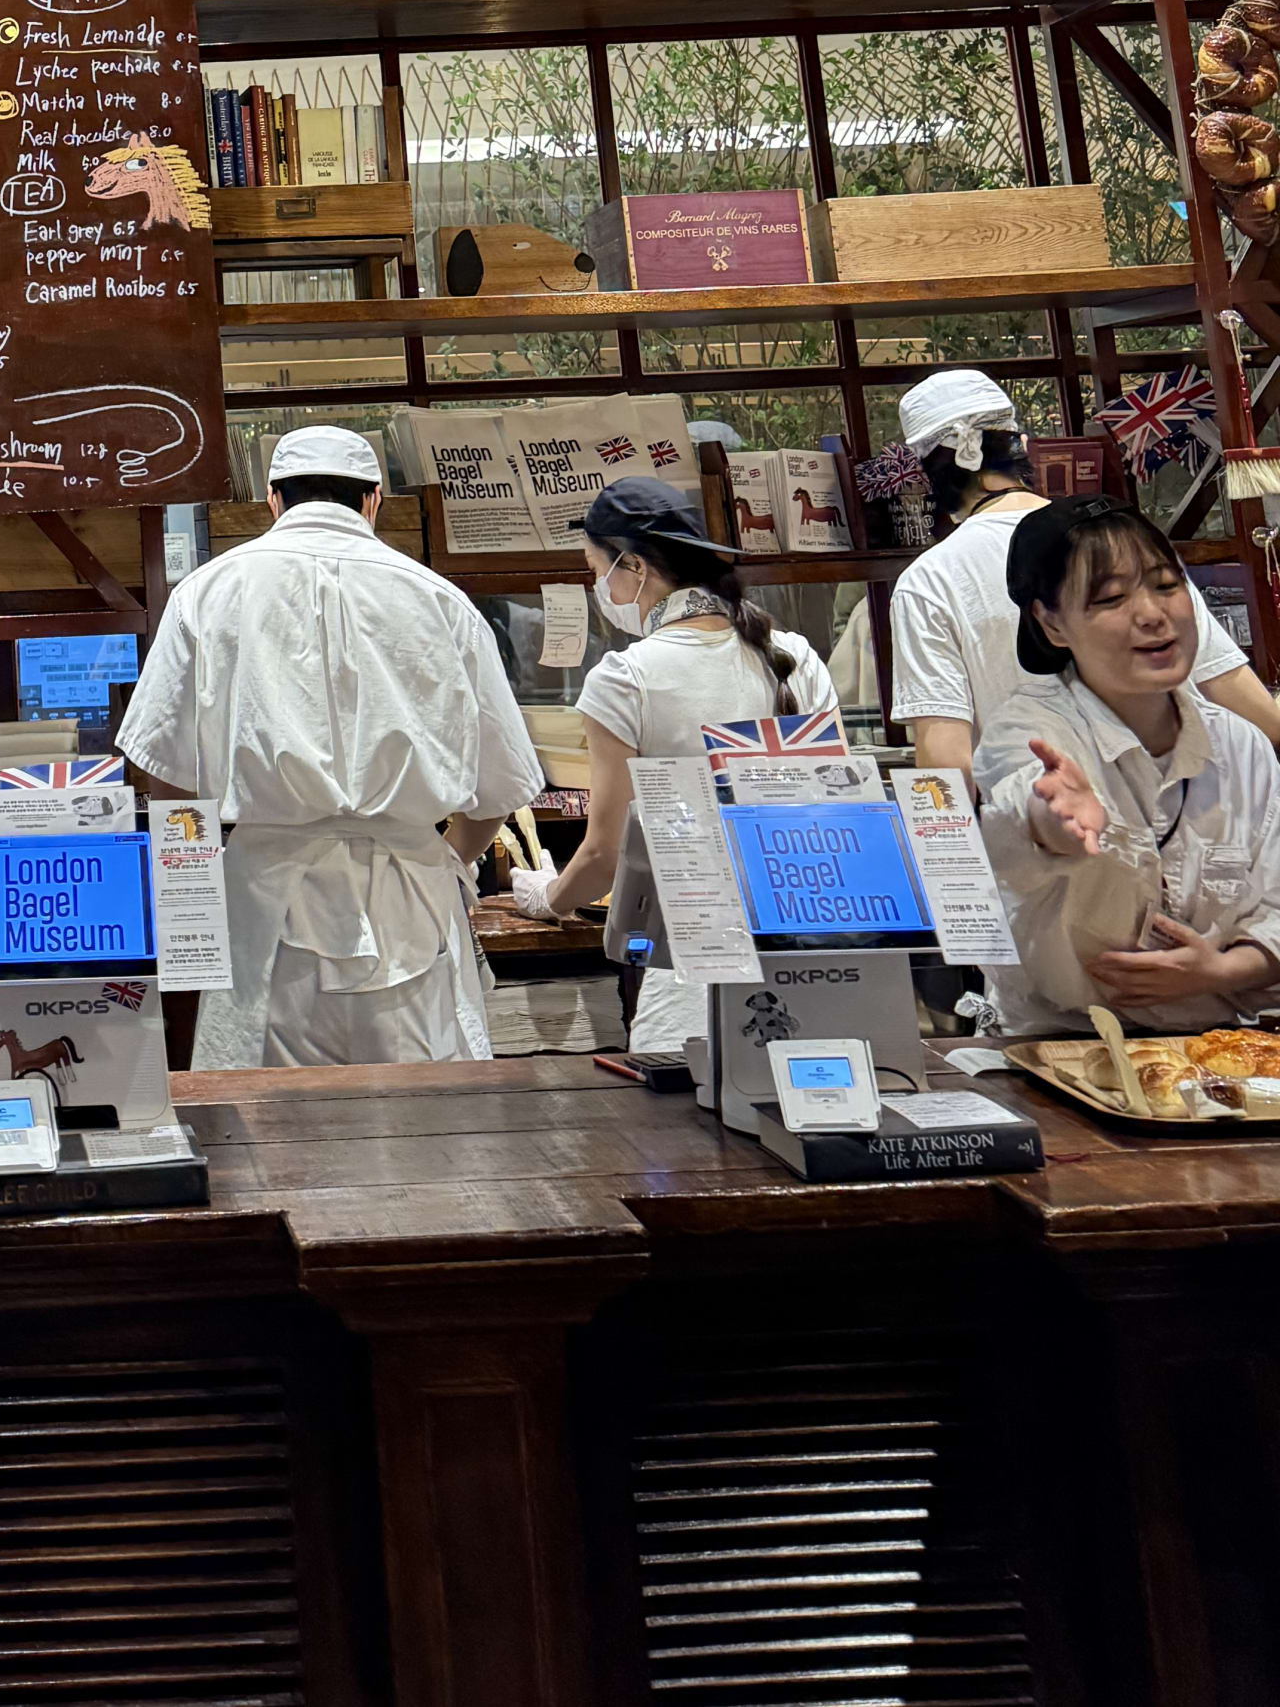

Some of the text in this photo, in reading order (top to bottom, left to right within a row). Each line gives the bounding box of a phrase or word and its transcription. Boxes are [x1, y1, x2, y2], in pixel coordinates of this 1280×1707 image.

[23, 21, 70, 49] Fresh
[82, 16, 166, 46] Lemonade
[16, 56, 79, 87] Lychee
[21, 88, 85, 117] Matcha
[96, 90, 136, 112] latte
[20, 119, 59, 147] Real
[149, 125, 171, 139] 8.0
[17, 150, 56, 172] Milk
[5, 177, 54, 216] TEA
[665, 209, 715, 225] Bernard
[24, 219, 136, 245] Earl grey 6.5
[636, 223, 798, 240] COMPOSITEUR DE VINS RARES
[25, 275, 199, 304] Caramel Rooibos 6.5
[431, 445, 493, 462] London
[519, 438, 581, 457] London
[436, 462, 483, 484] Bagel
[525, 455, 573, 477] Bagel
[440, 481, 514, 500] Museum
[531, 471, 605, 497] Museum
[755, 822, 861, 855] London
[5, 852, 103, 886] London
[763, 854, 845, 894] Bagel
[5, 885, 78, 925] Bagel
[773, 891, 900, 924] Museum
[5, 921, 125, 954] Museum
[774, 968, 860, 985] OKPOS
[25, 1000, 110, 1016] OKPOS
[868, 1133, 995, 1154] KATE ATKINSON
[884, 1151, 984, 1170] Life After Life
